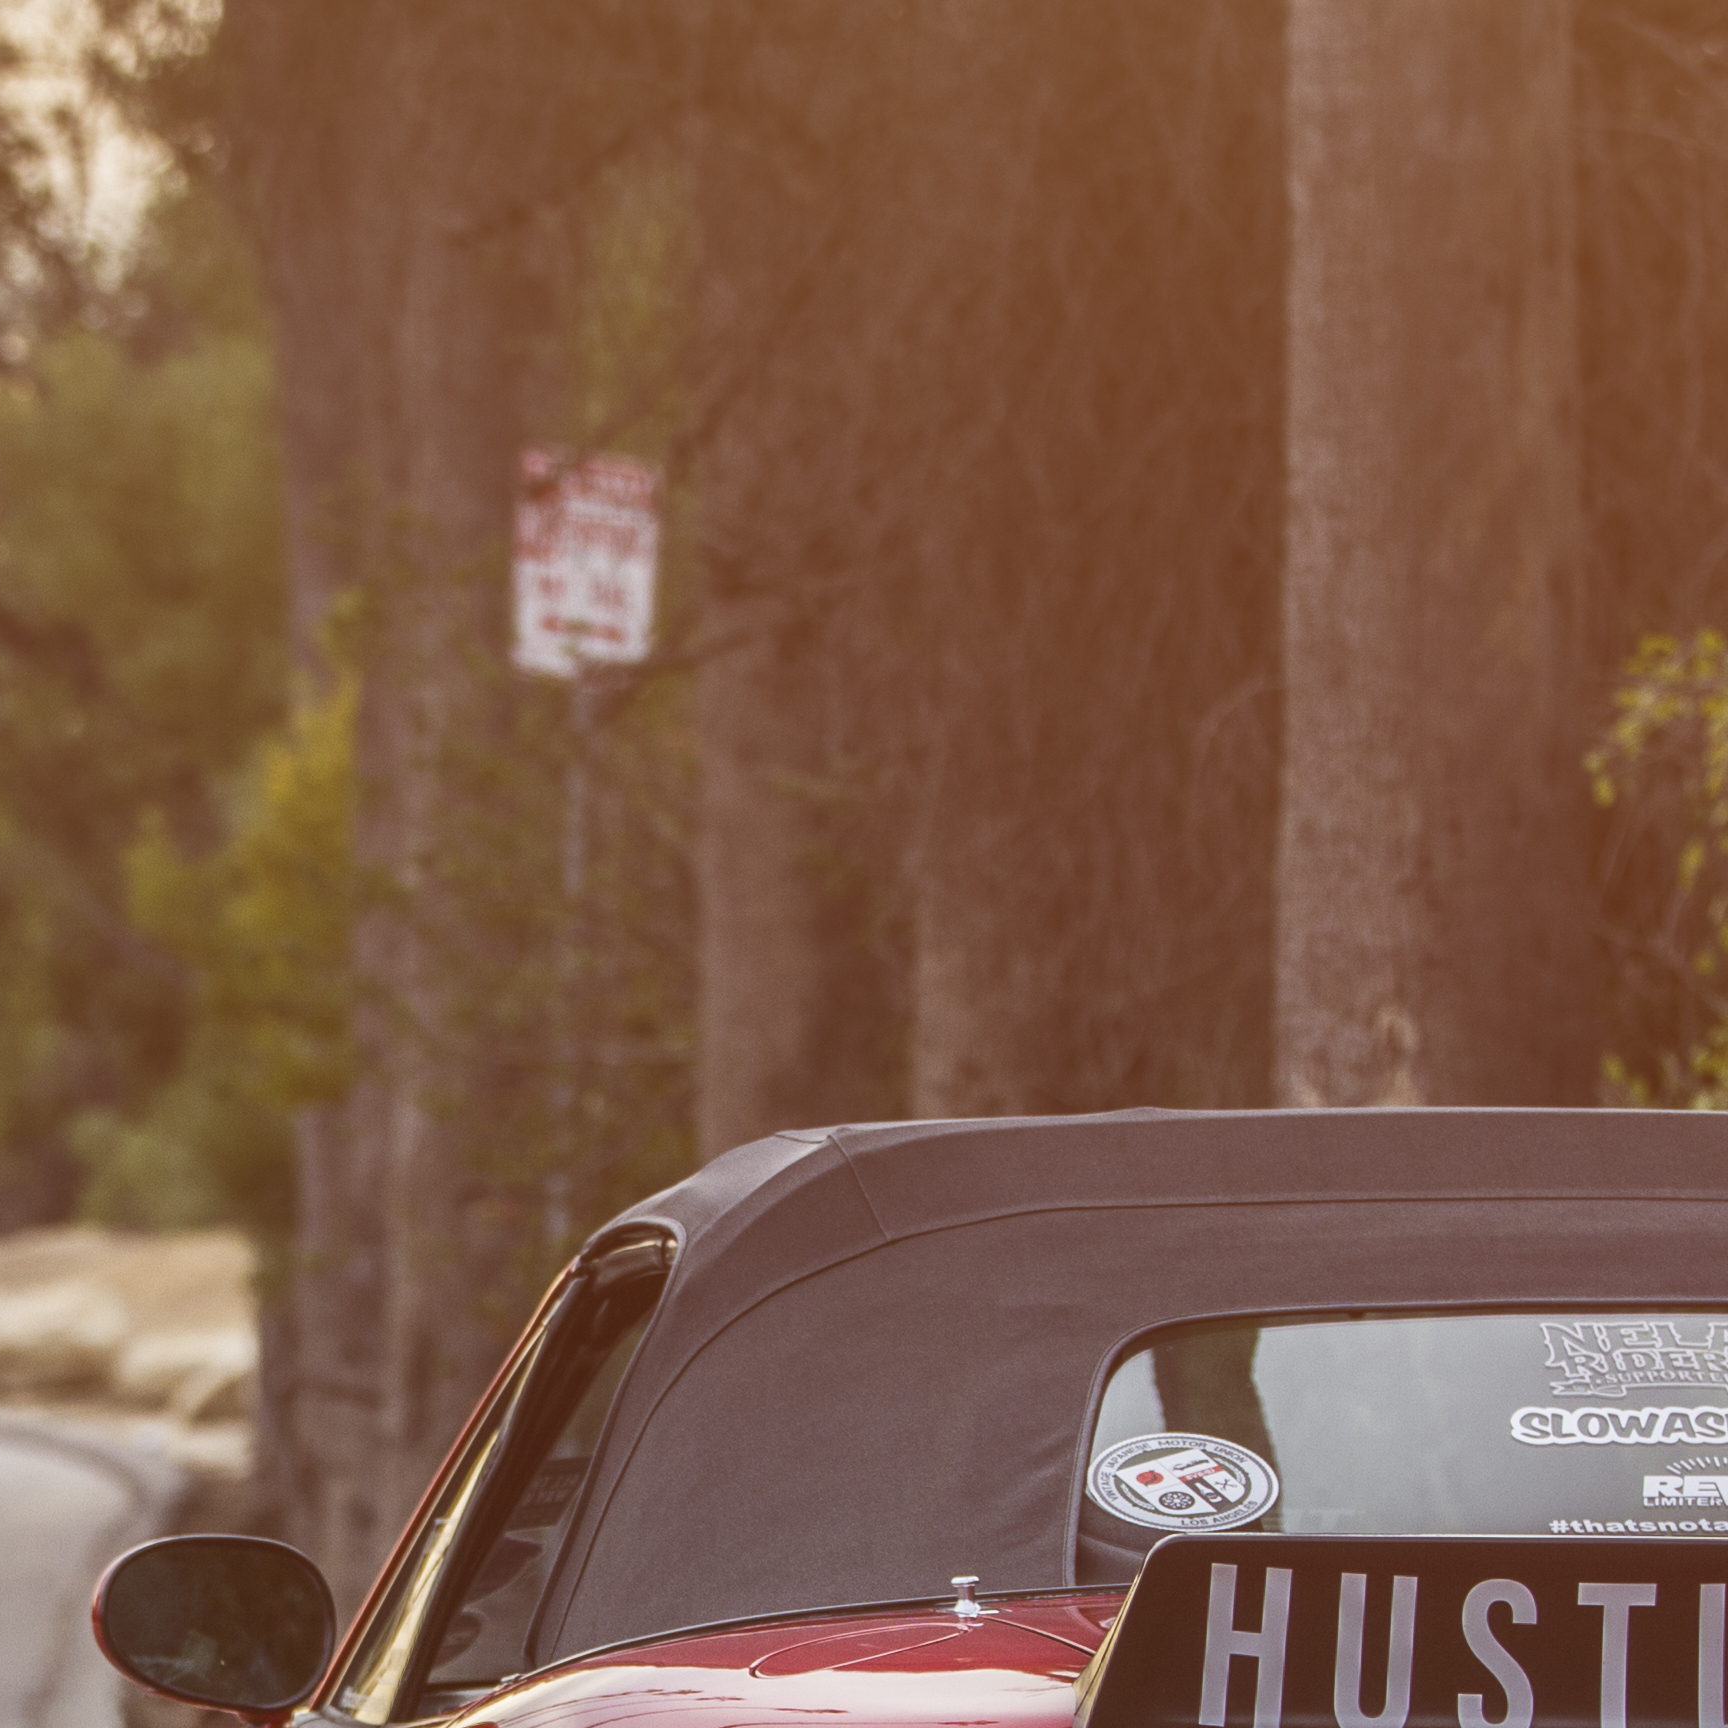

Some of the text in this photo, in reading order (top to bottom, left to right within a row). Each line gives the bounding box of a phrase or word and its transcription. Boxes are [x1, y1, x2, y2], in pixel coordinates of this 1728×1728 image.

[1105, 1442, 1150, 1469] JAPANESE
[1158, 1440, 1207, 1448] MOTOR
[1214, 1446, 1248, 1463] UNION
[1213, 1500, 1258, 1524] ANGELES
